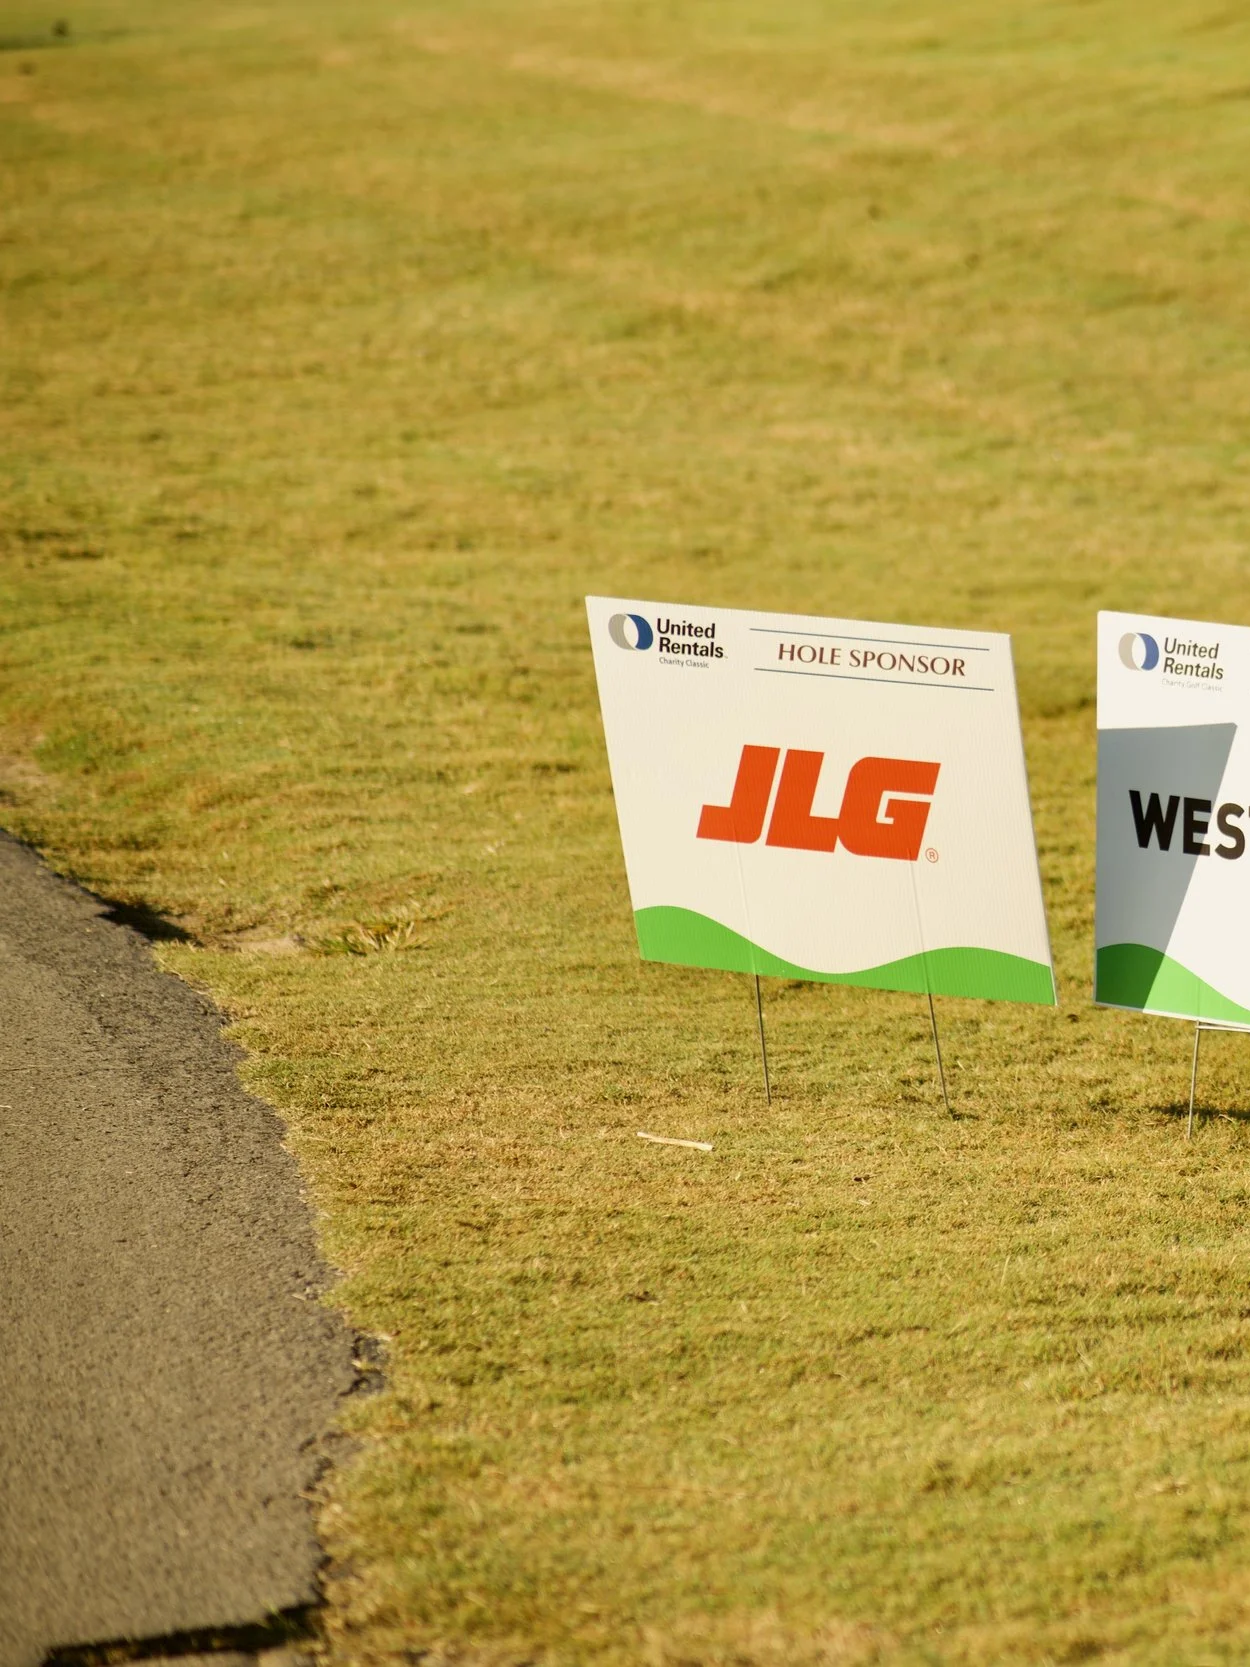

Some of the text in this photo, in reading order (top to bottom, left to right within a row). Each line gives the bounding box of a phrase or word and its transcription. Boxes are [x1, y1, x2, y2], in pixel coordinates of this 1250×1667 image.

[657, 618, 716, 638] United
[659, 637, 724, 659] Rentals
[1164, 637, 1219, 659] United
[659, 657, 709, 668] Charity Classic
[778, 643, 966, 676] HOLE SPONSOR
[1163, 657, 1224, 680] Rentals
[696, 744, 941, 861] JLG
